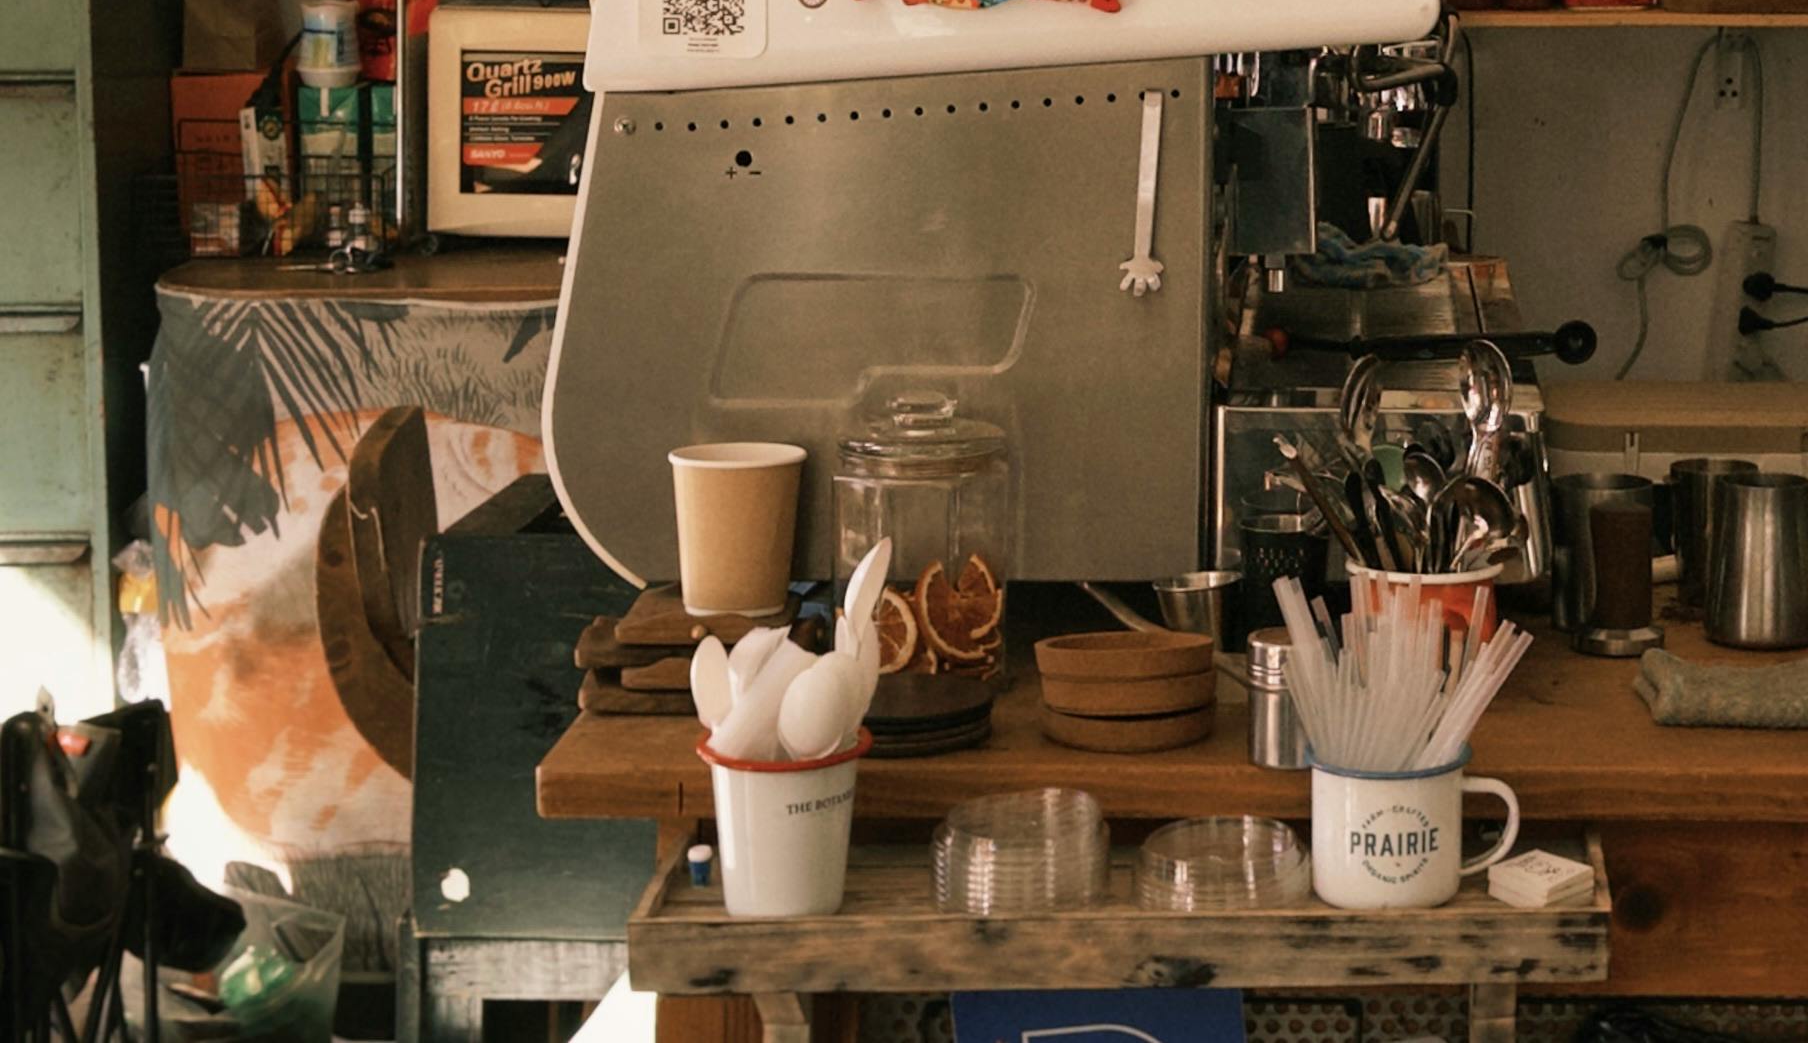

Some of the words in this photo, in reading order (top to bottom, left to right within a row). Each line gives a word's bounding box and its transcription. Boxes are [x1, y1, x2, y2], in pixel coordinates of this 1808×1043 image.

[466, 58, 543, 82] Quartz
[484, 74, 532, 98] Grill
[532, 70, 577, 91] 900W
[785, 802, 812, 816] THE
[1349, 827, 1439, 857] PRAIRIE
